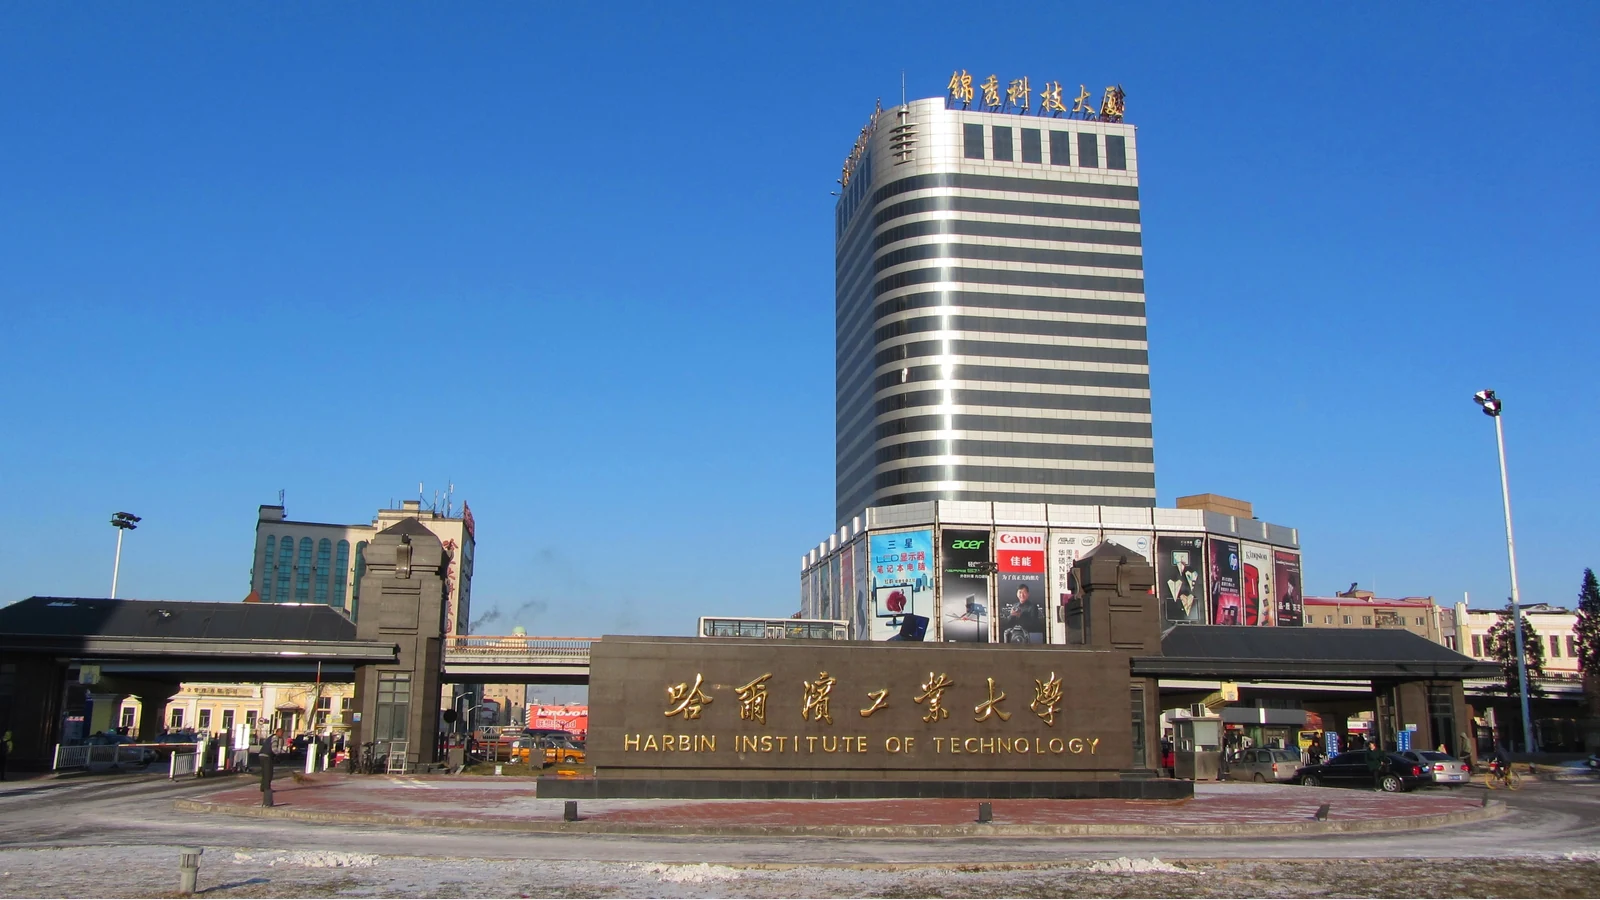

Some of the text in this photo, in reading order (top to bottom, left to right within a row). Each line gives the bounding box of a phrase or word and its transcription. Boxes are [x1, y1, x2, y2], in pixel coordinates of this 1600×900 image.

[887, 538, 913, 549] 三星
[952, 540, 985, 549] acer
[1000, 534, 1041, 544] Canon
[1245, 550, 1267, 561] Kingston
[1010, 556, 1031, 567] 佳能
[877, 562, 926, 574] 笔记本电脑
[1058, 549, 1066, 589] 华硕N系列
[537, 708, 581, 717] lenovo
[624, 733, 1101, 756] HARBIN INSTITUTE OF TECHNOLOGY
